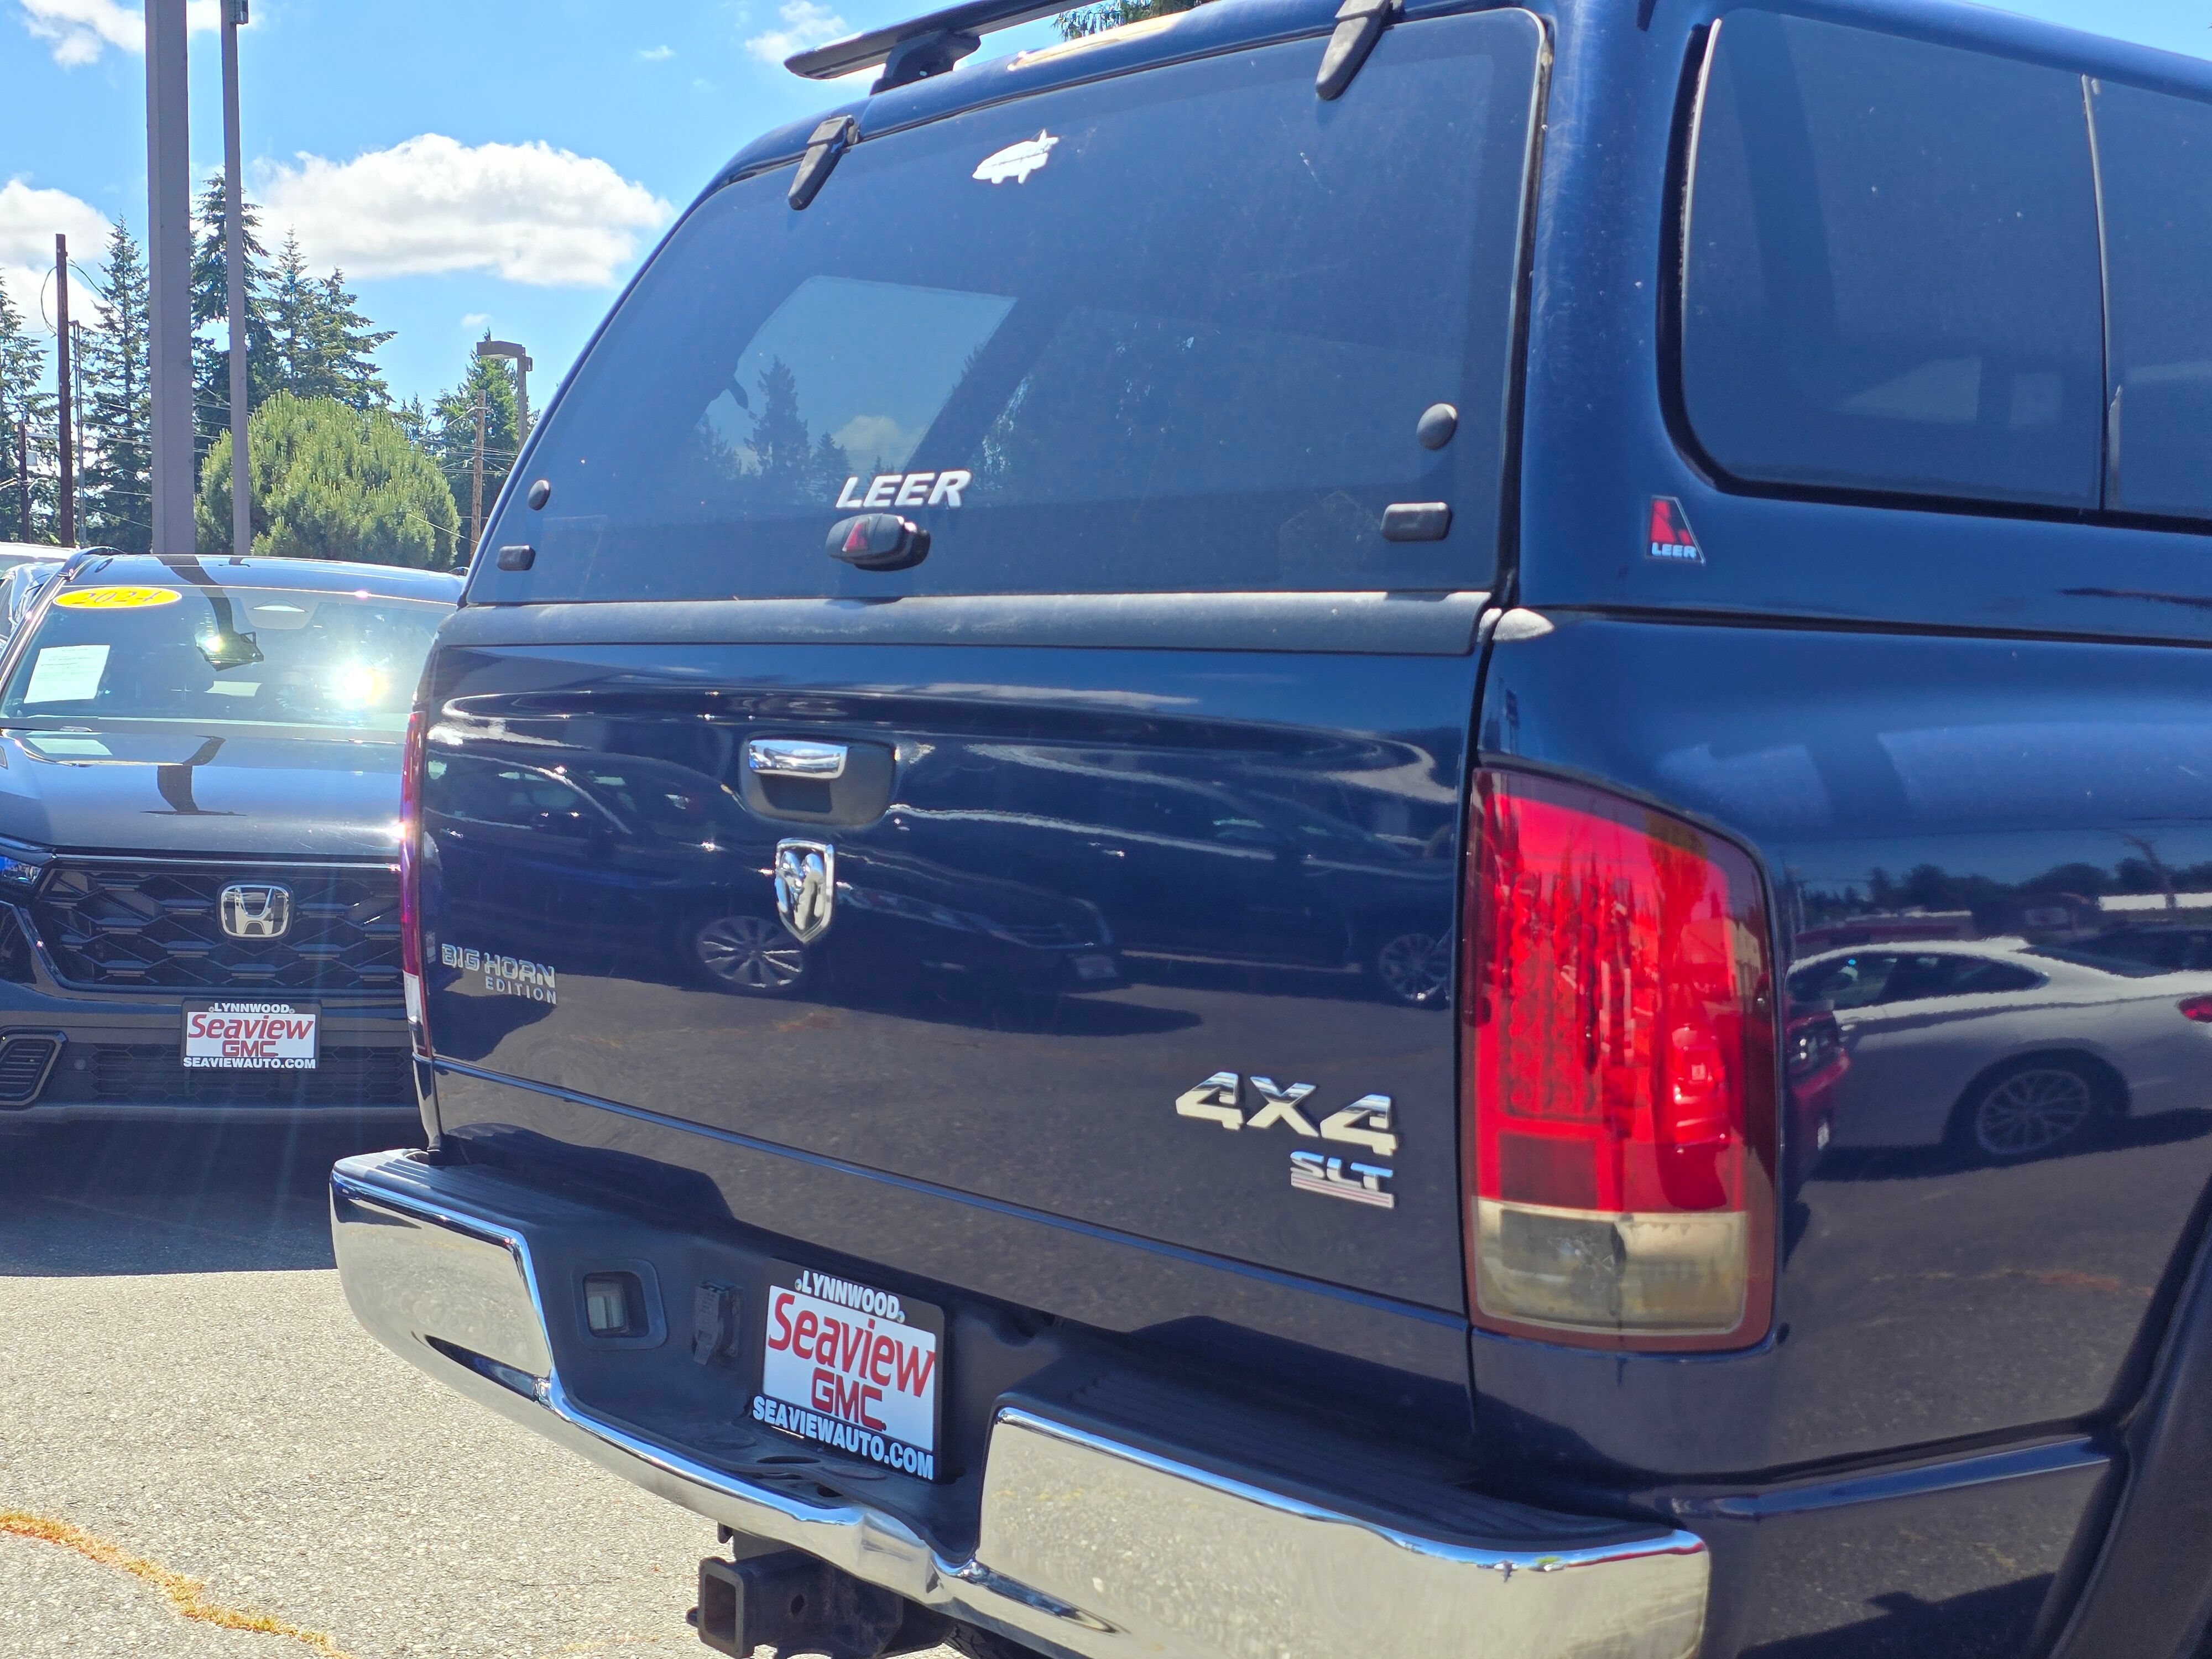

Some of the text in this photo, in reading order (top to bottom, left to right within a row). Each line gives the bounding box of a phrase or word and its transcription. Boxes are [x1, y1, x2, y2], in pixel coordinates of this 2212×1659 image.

[836, 469, 972, 509] LEER
[1651, 542, 1697, 559] LEER
[70, 591, 163, 604] 2024
[442, 943, 555, 988] BIG HORN
[485, 975, 557, 1005] EDITION
[213, 1003, 290, 1014] LYNNWOOD
[188, 1014, 314, 1040] Seaview
[183, 1057, 316, 1069] SEAVIEWAUTO.COM
[222, 1040, 278, 1057] GMC
[1290, 1150, 1394, 1192] SLT
[801, 1270, 900, 1319] LYNNWOOD
[768, 1292, 936, 1398] Seaview
[811, 1367, 885, 1431] GMC
[753, 1395, 933, 1480] SEAVIEWAUTO.COM
